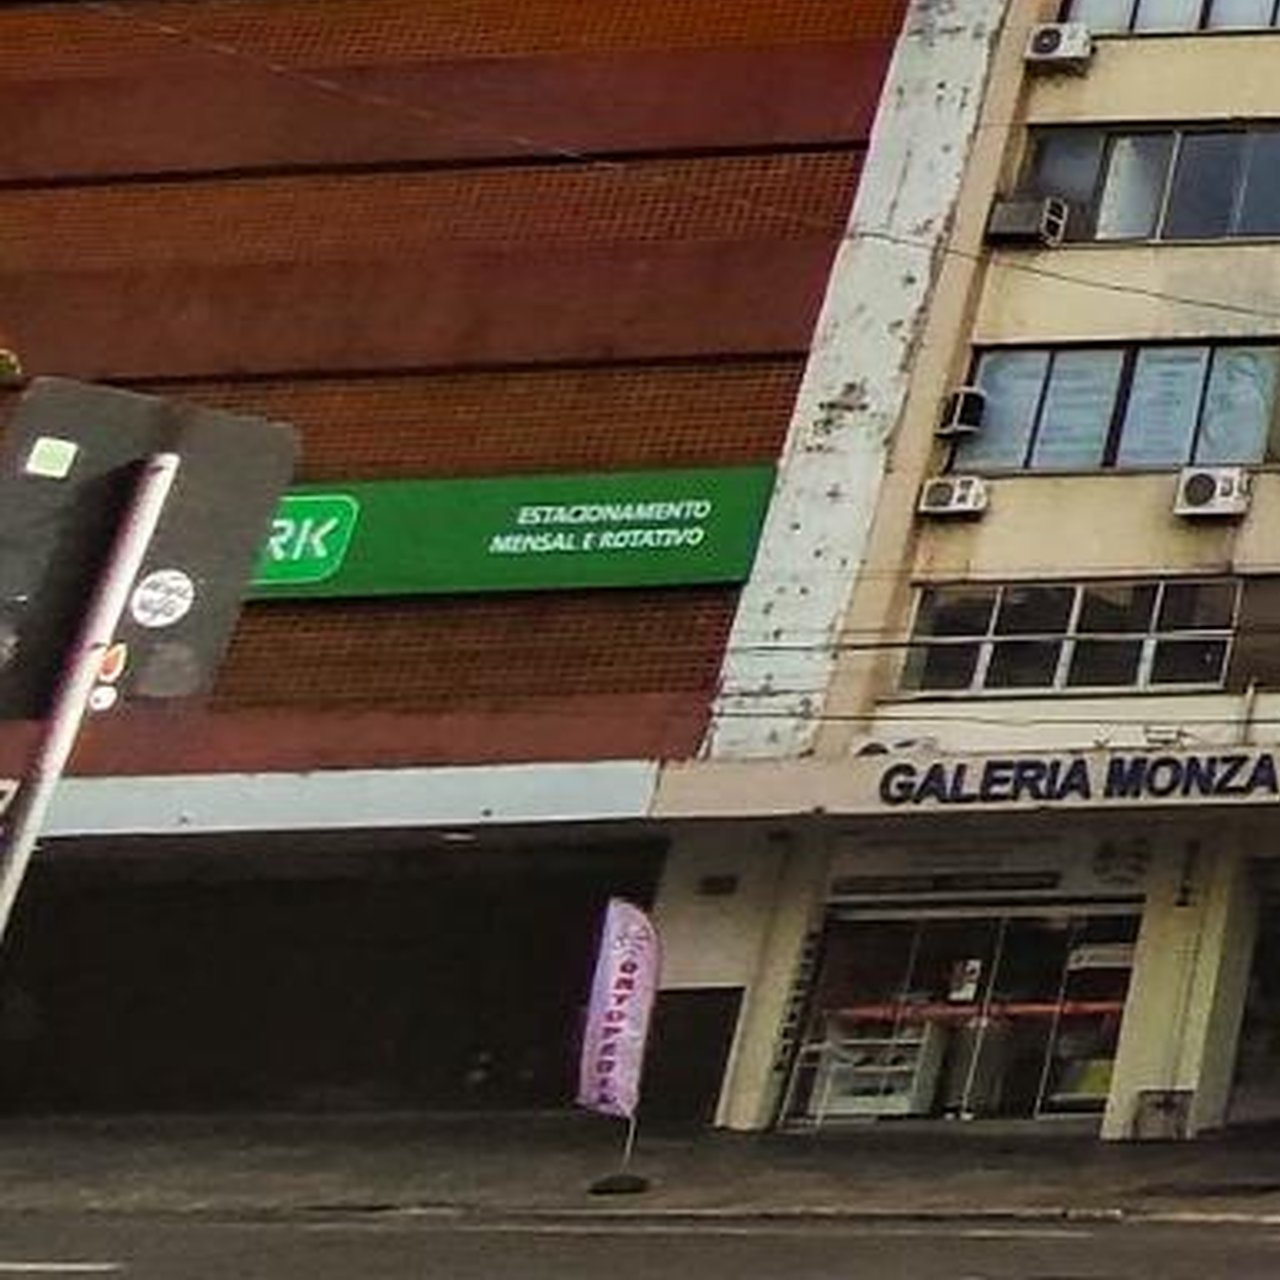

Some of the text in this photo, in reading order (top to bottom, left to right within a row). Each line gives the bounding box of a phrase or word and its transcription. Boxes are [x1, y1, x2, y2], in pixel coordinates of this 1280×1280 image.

[517, 500, 712, 525] ESTACIONAMENTO
[489, 527, 705, 553] MENSAL E ROTATIVO
[879, 753, 1280, 805] GALERIA MONZA
